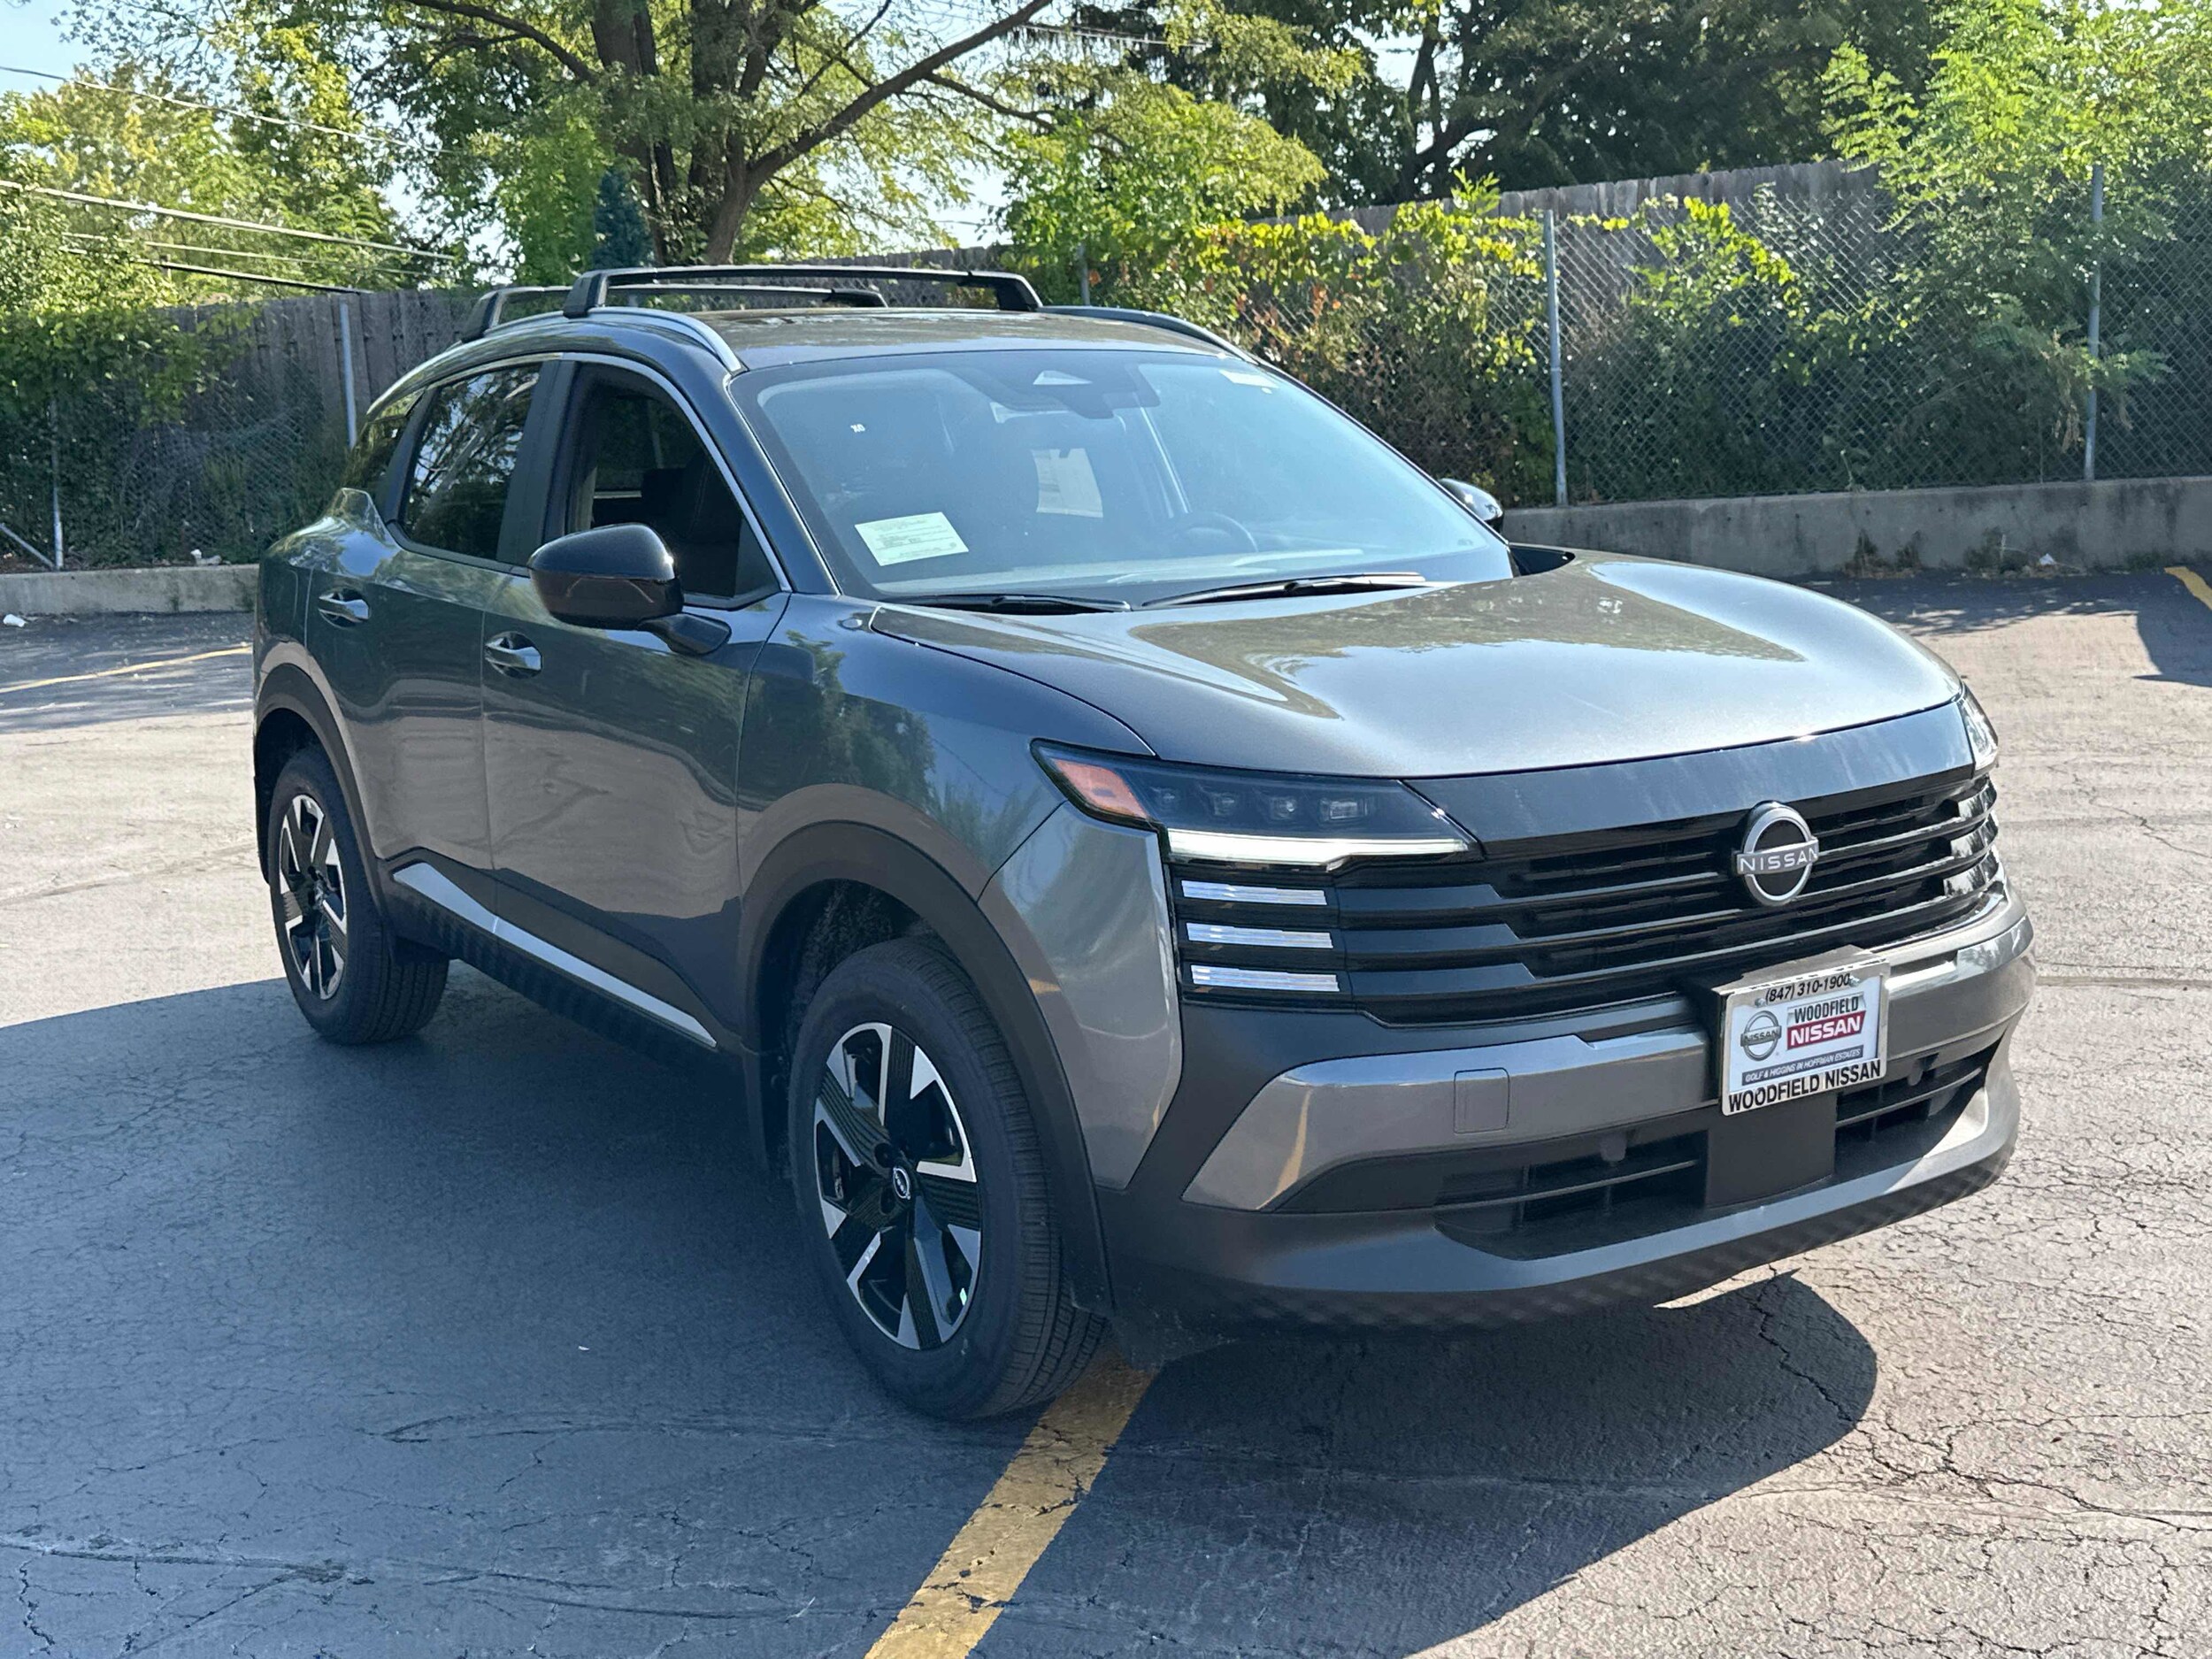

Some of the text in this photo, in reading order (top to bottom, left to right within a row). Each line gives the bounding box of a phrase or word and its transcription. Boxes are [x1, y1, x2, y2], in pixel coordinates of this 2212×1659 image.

[1740, 849, 1818, 872] NISSAN
[1765, 972, 1851, 1005] (847) 310-1900
[1794, 996, 1859, 1024] WOODFIELD
[1744, 1030, 1779, 1043] NISSAN
[1791, 1016, 1861, 1046] NISSAN
[1745, 1071, 1763, 1083] GOLF
[1770, 1063, 1796, 1077] HIGGINS
[1804, 1055, 1834, 1068] HOFFMAN
[1834, 1048, 1861, 1062] ESTATES
[1729, 1060, 1881, 1112] WOODFIELD NISSAN
